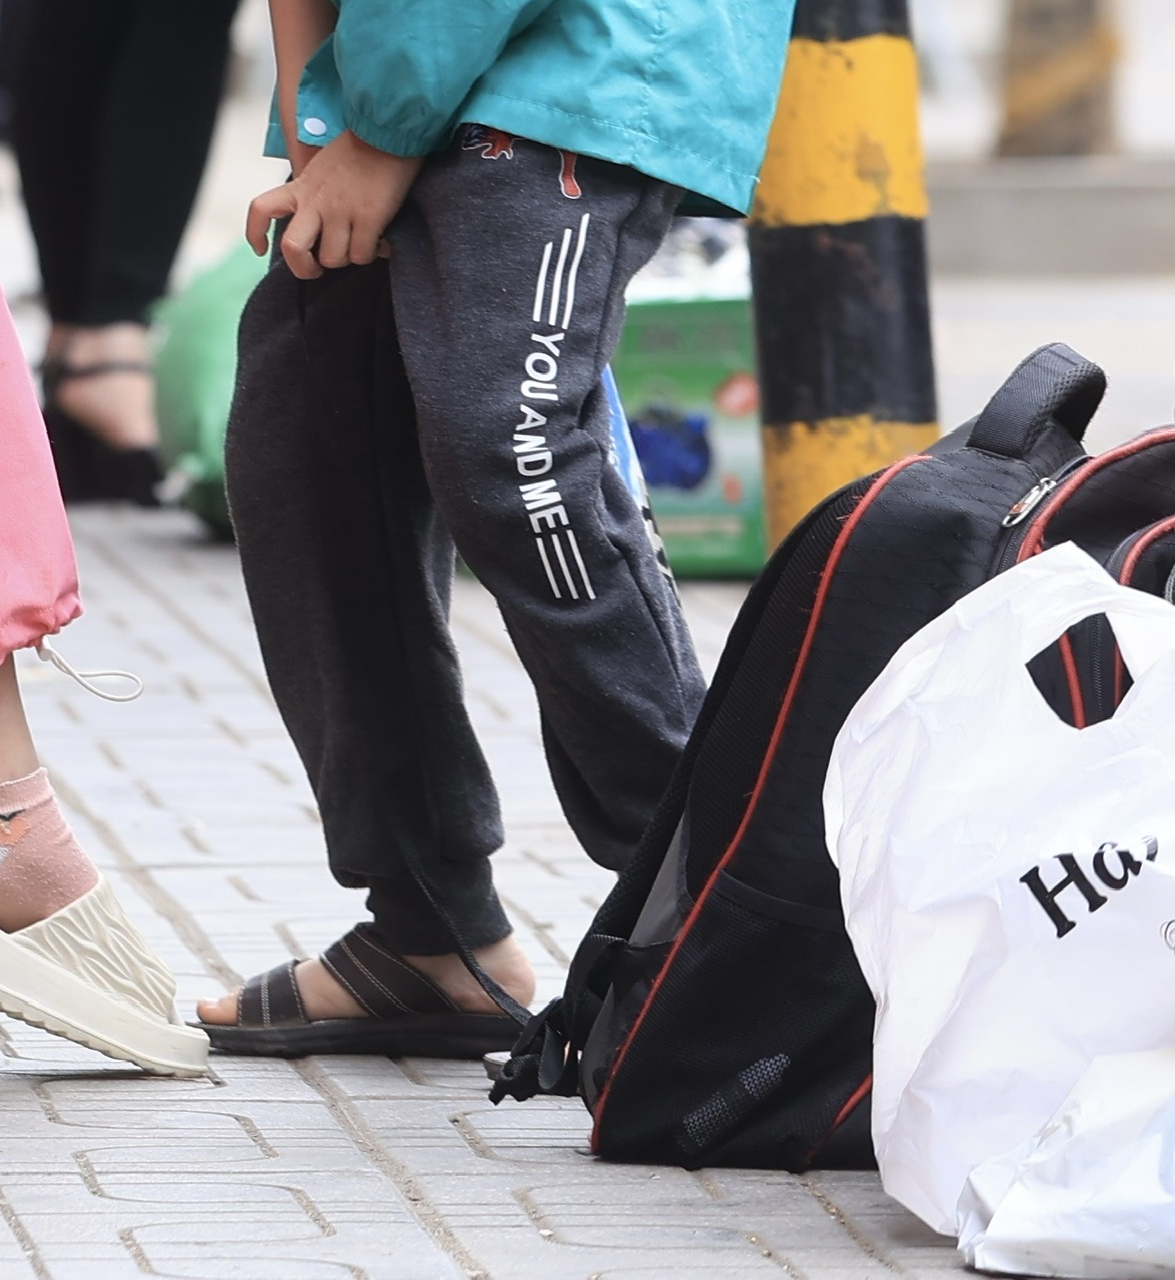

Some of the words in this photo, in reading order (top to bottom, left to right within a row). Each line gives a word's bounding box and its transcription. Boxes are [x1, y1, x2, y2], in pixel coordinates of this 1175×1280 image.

[520, 332, 565, 401] YOU
[512, 403, 554, 477] AND
[518, 478, 570, 534] ME
[1019, 834, 1159, 939] Ha
